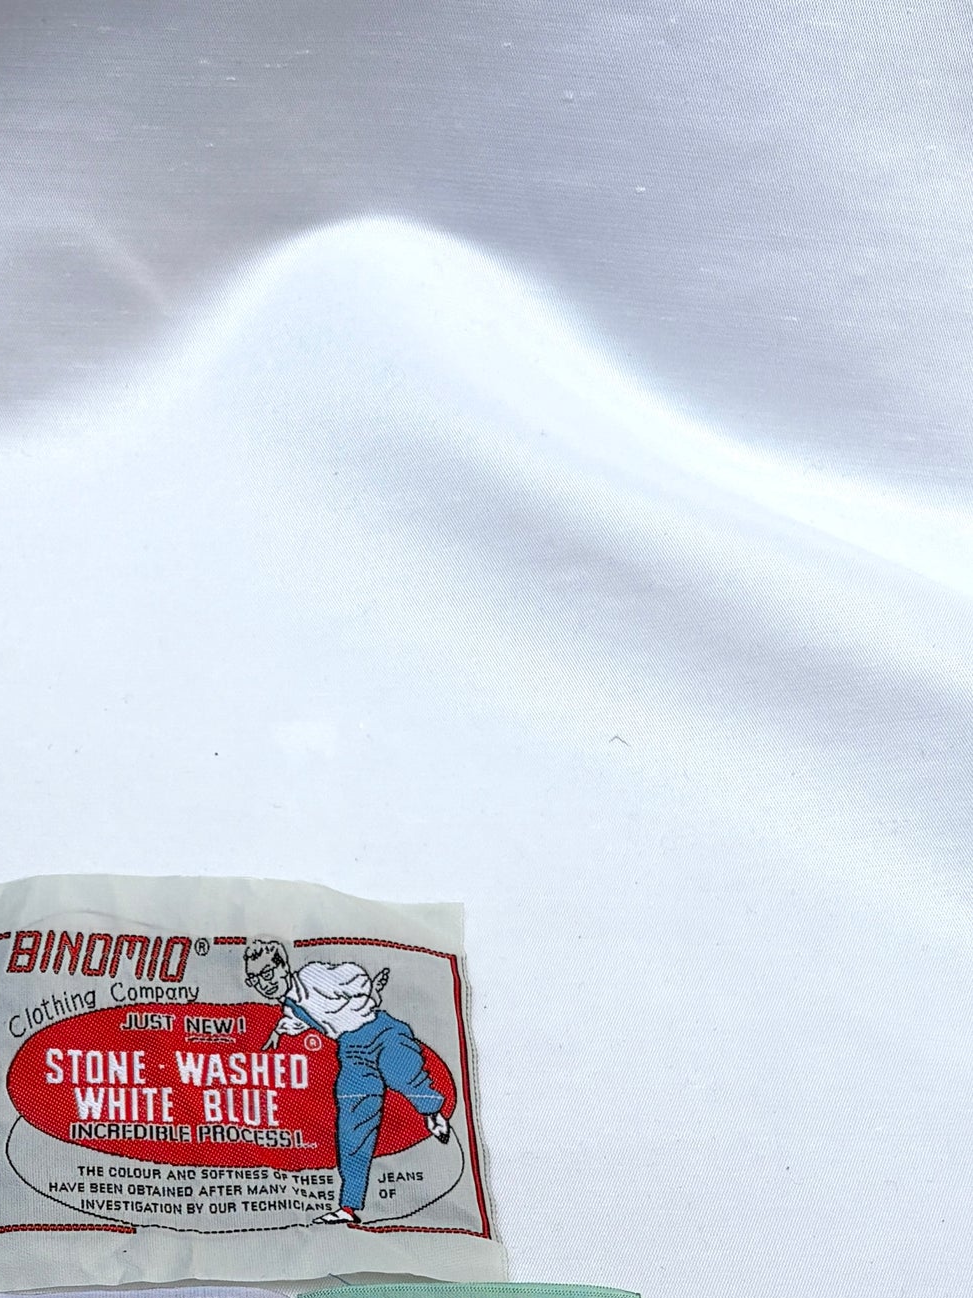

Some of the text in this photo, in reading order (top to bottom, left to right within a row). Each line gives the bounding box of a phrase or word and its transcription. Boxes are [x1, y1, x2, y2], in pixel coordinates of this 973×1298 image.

[9, 982, 199, 1038] Clothing Company
[121, 1013, 175, 1031] JUST
[45, 1048, 146, 1085] STONE
[175, 1050, 310, 1090] WASHED
[74, 1086, 280, 1126] WHITE BLUE
[70, 1122, 191, 1143] INCREDIBLE
[78, 1166, 424, 1185] THE COLOUR AND SOFTNESS OF THESE JEANS
[49, 1182, 397, 1200] HAVE BEEN OBTAINED AFTER MANY YEARS OF
[81, 1199, 333, 1214] INVESTIGATION BY OUR TECHNICIANS
